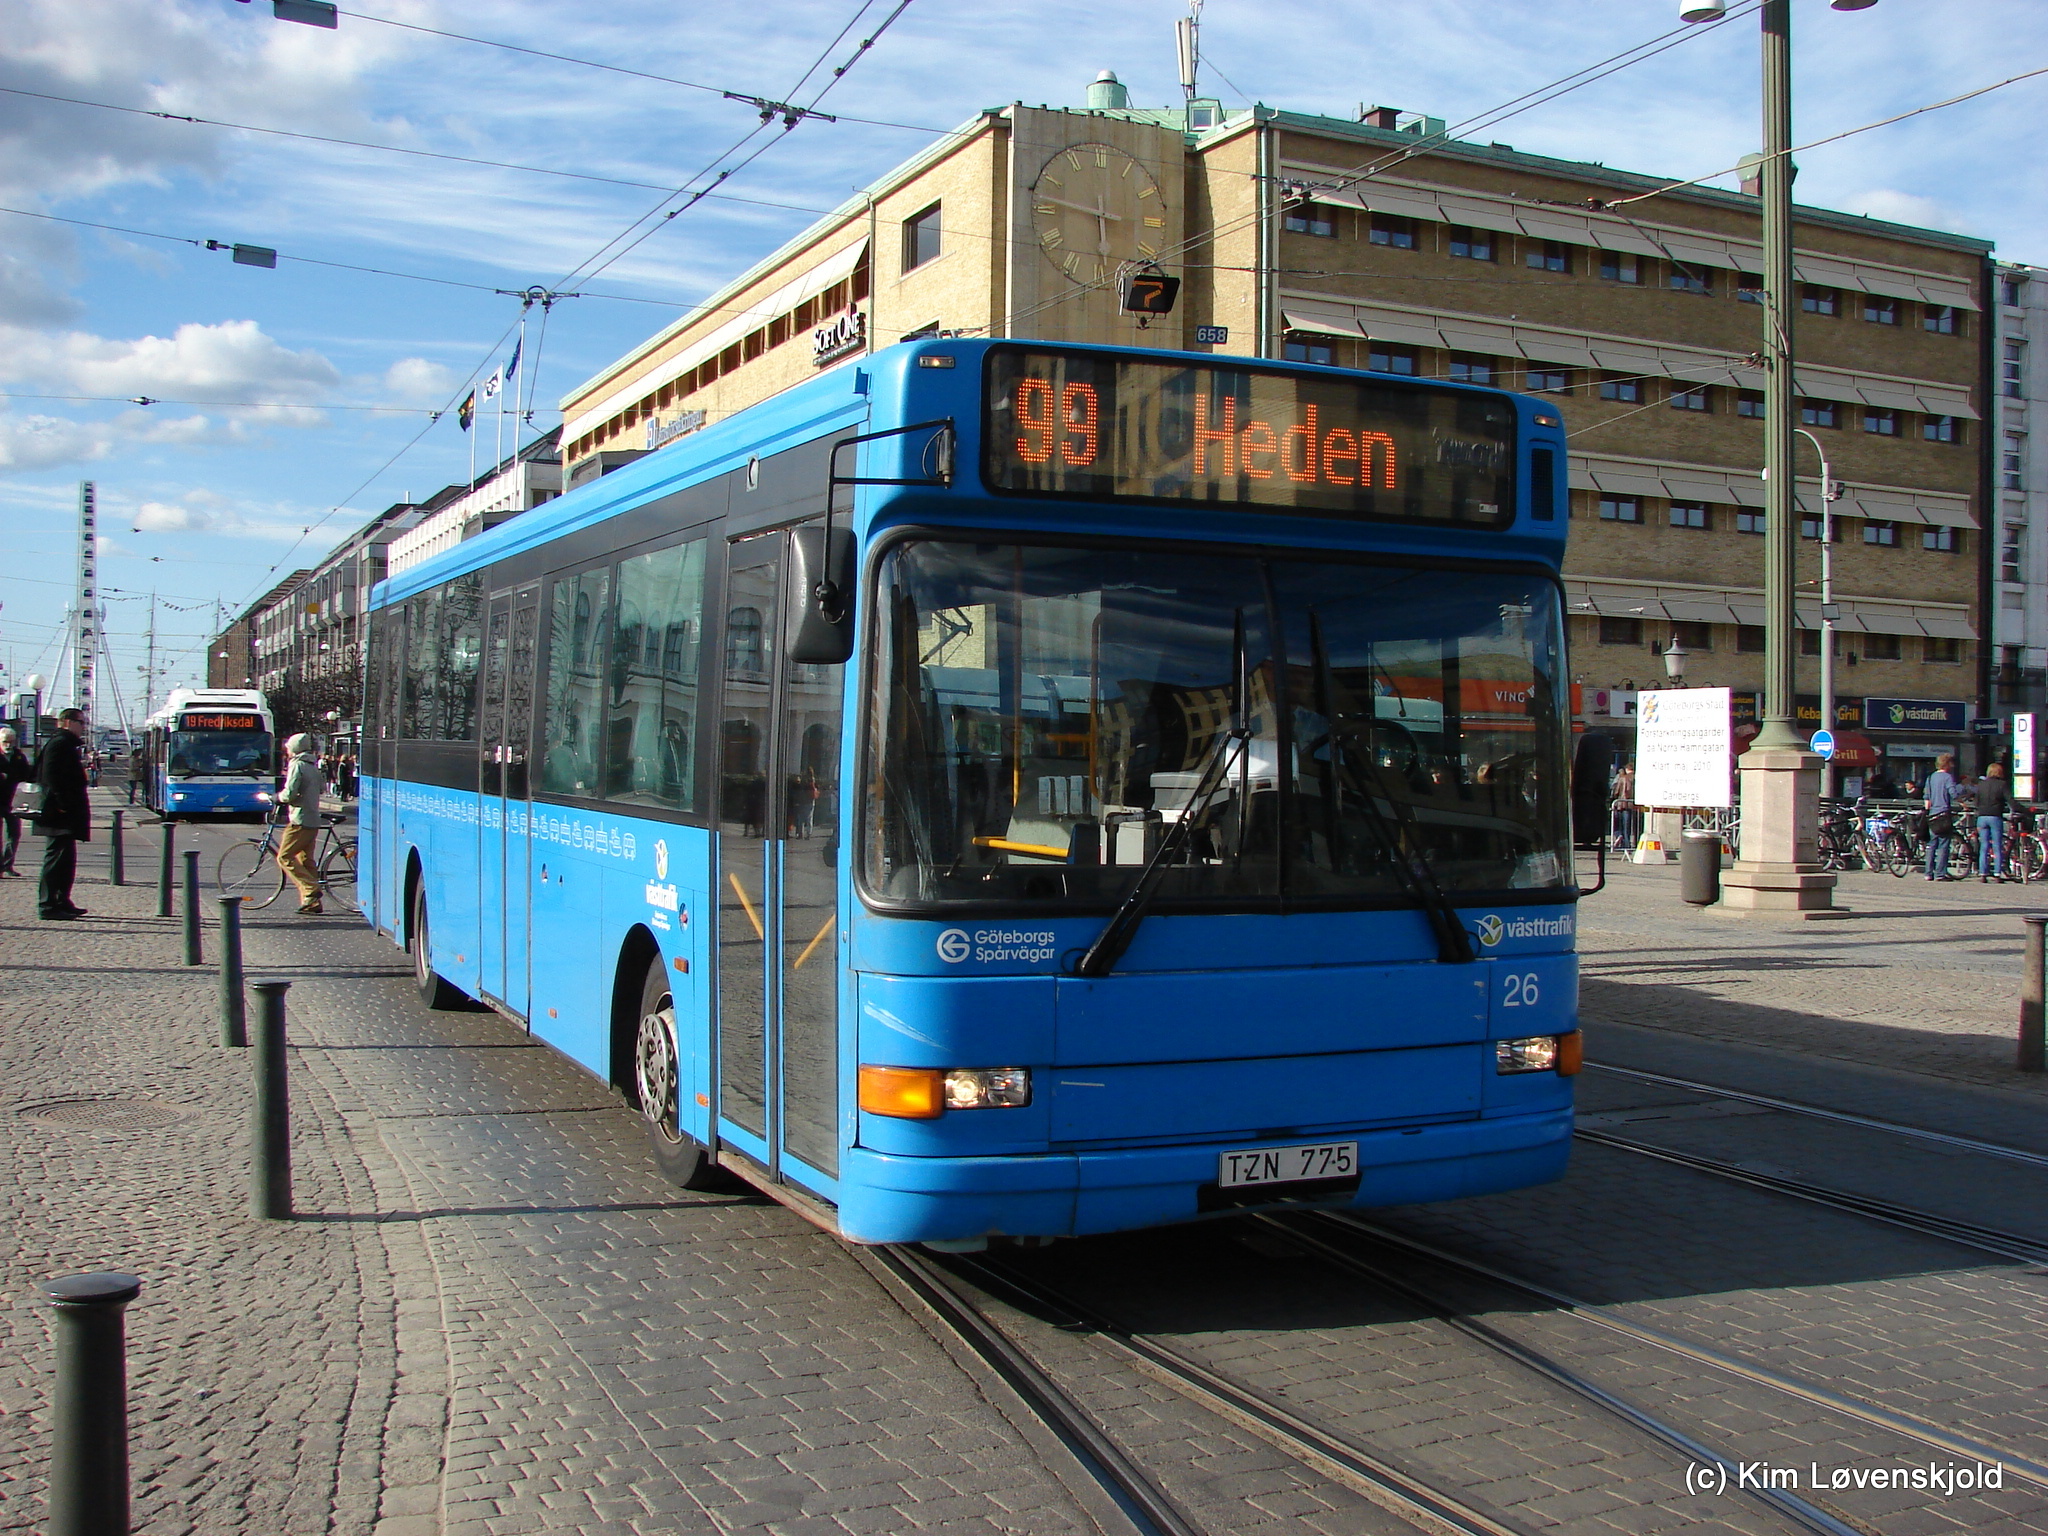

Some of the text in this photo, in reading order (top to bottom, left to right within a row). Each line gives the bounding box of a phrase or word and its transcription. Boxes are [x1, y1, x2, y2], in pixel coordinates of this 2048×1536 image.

[813, 326, 836, 354] SOFT
[837, 312, 860, 340] ONE
[1197, 328, 1227, 342] 658
[1016, 378, 1396, 489] 99 Heden
[1495, 691, 1525, 703] VING
[27, 701, 35, 709] A
[186, 715, 196, 727] 19
[1797, 706, 1860, 721] Keba Grill
[1905, 706, 1947, 721] västtrafik
[2018, 718, 2028, 732] D
[1834, 749, 1858, 760] Grill
[1506, 915, 1573, 937] västtrafik
[975, 930, 1055, 946] Göteborgs
[975, 945, 1055, 963] Spårvägar
[1503, 972, 1538, 1007] 26
[1228, 1146, 1351, 1182] TZN 775
